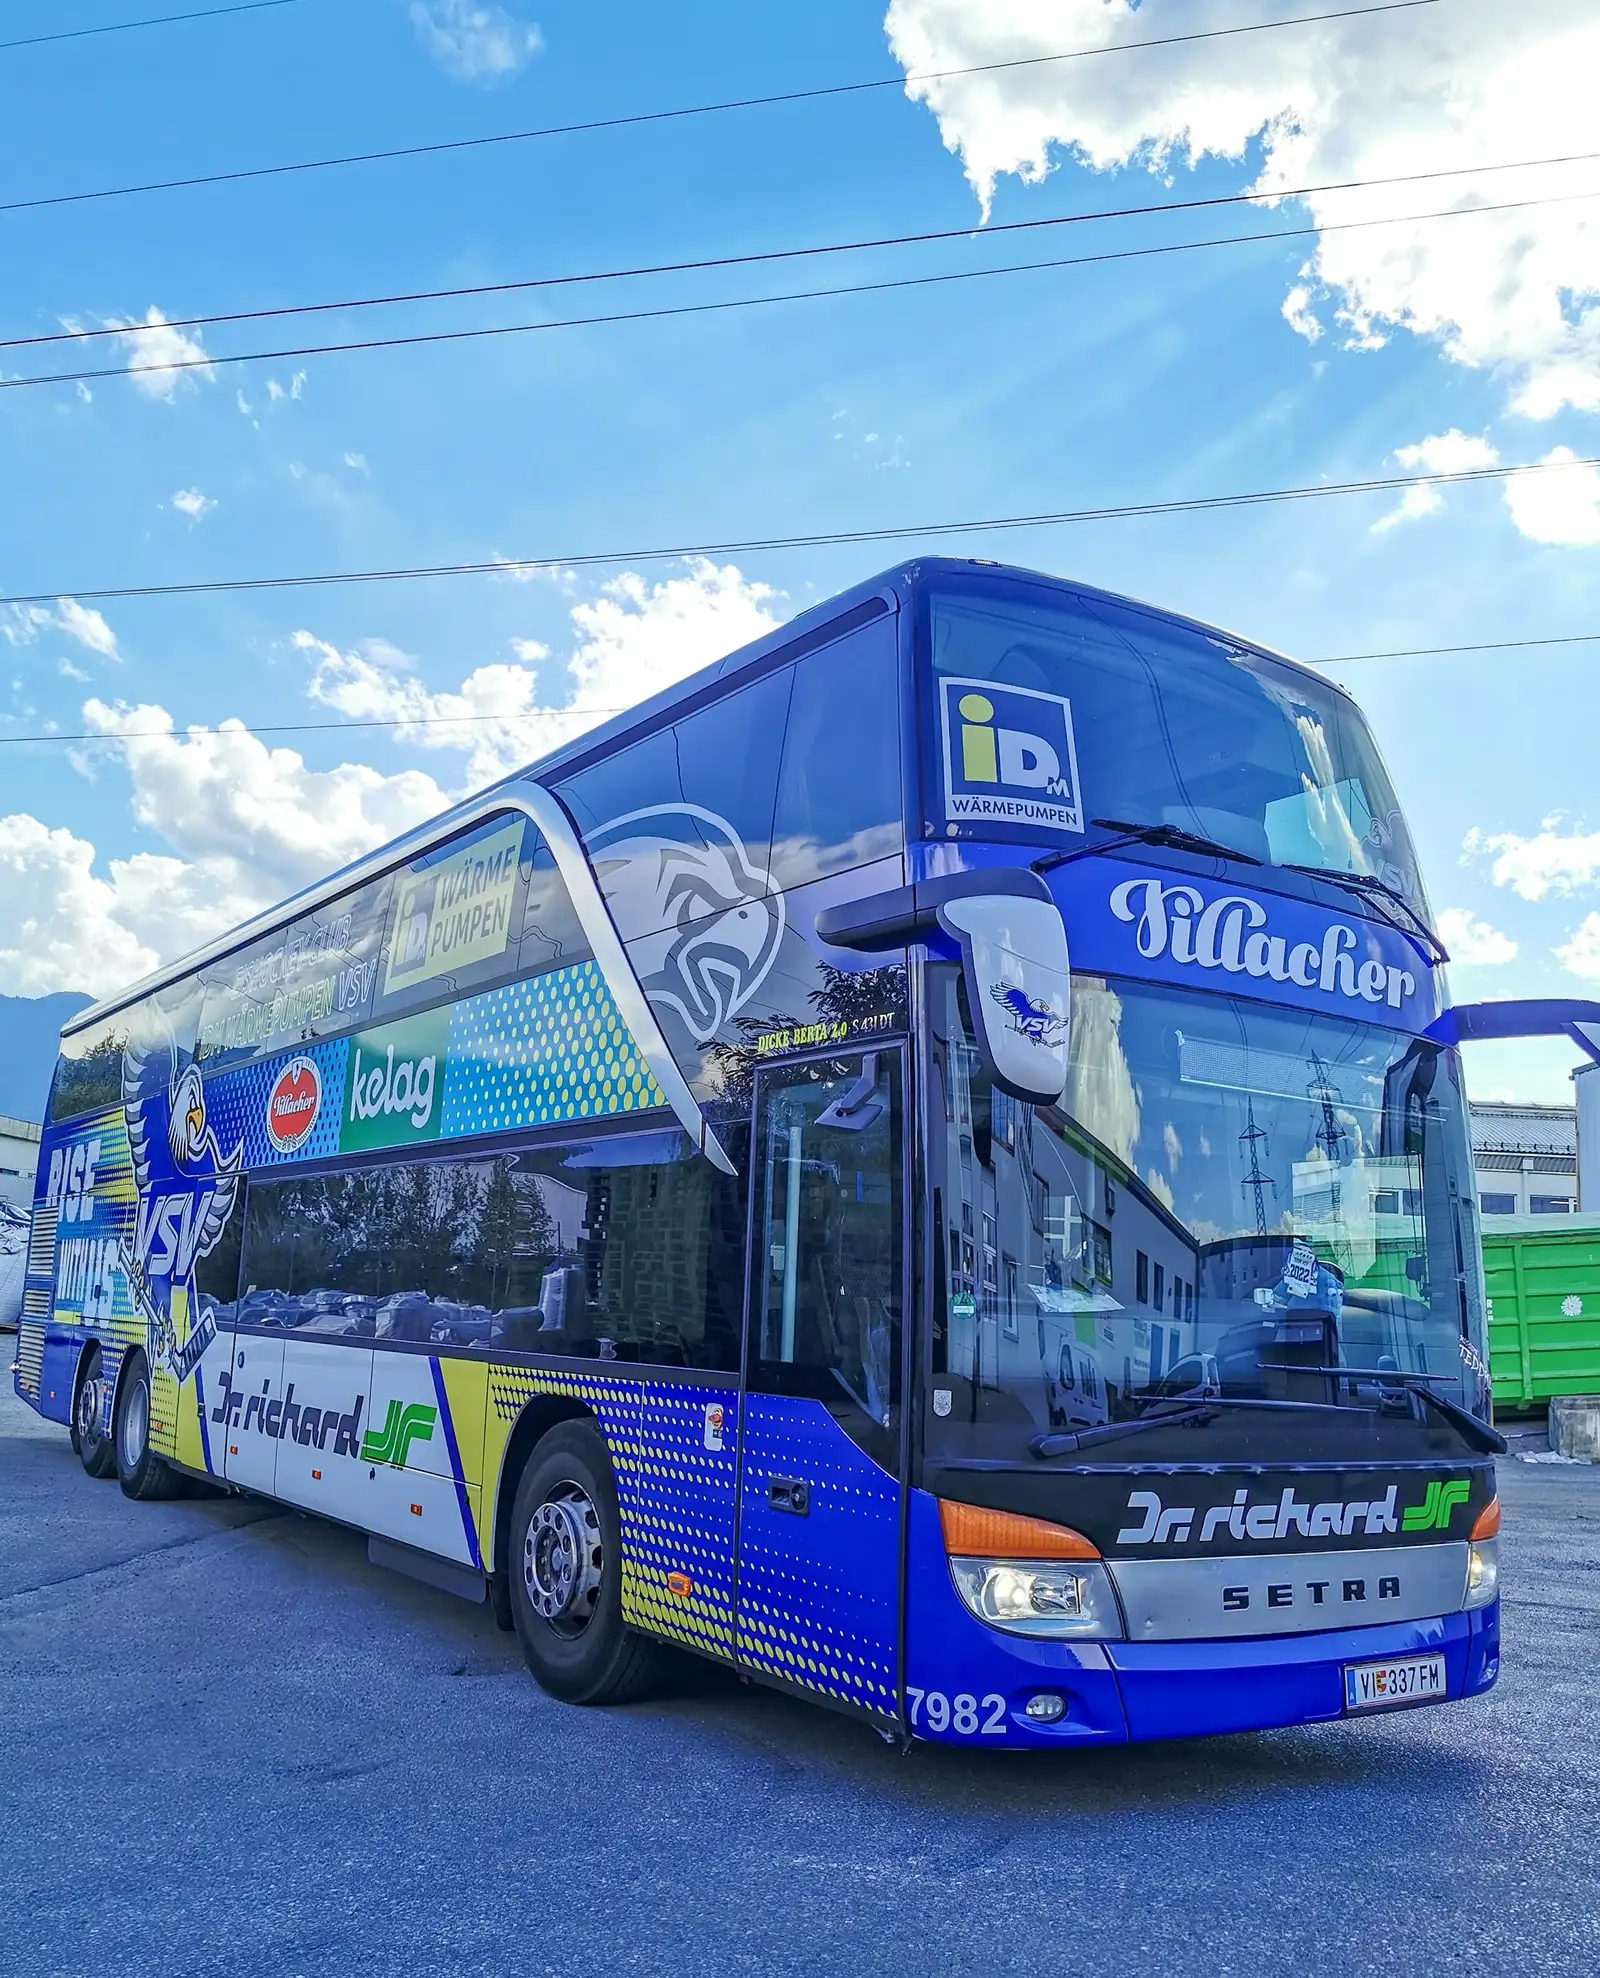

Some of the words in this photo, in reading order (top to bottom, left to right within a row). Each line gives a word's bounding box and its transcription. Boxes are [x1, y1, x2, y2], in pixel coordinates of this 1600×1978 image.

[952, 796, 1077, 825] WÄRMEPUMPEN
[440, 845, 516, 910] WÄRME
[430, 894, 508, 957] PUMPEN
[1109, 879, 1416, 1008] Villacher
[338, 958, 377, 1011] VSV
[758, 1031, 789, 1052] DICKE
[793, 1023, 828, 1044] BERTA
[1016, 1014, 1059, 1033] VSV
[273, 1090, 316, 1117] Villacher
[350, 1044, 436, 1128] kelag
[45, 1138, 101, 1223] RISE
[135, 1191, 215, 1276] VSV
[83, 1238, 118, 1329] US
[1290, 1263, 1310, 1284] 2022
[243, 1379, 364, 1459] richard
[1199, 1485, 1398, 1542] richard
[1223, 1576, 1401, 1612] SETRA
[1361, 1672, 1376, 1699] VI
[1388, 1667, 1416, 1694] 337
[1419, 1664, 1439, 1690] FM
[906, 1686, 1007, 1734] 7982
